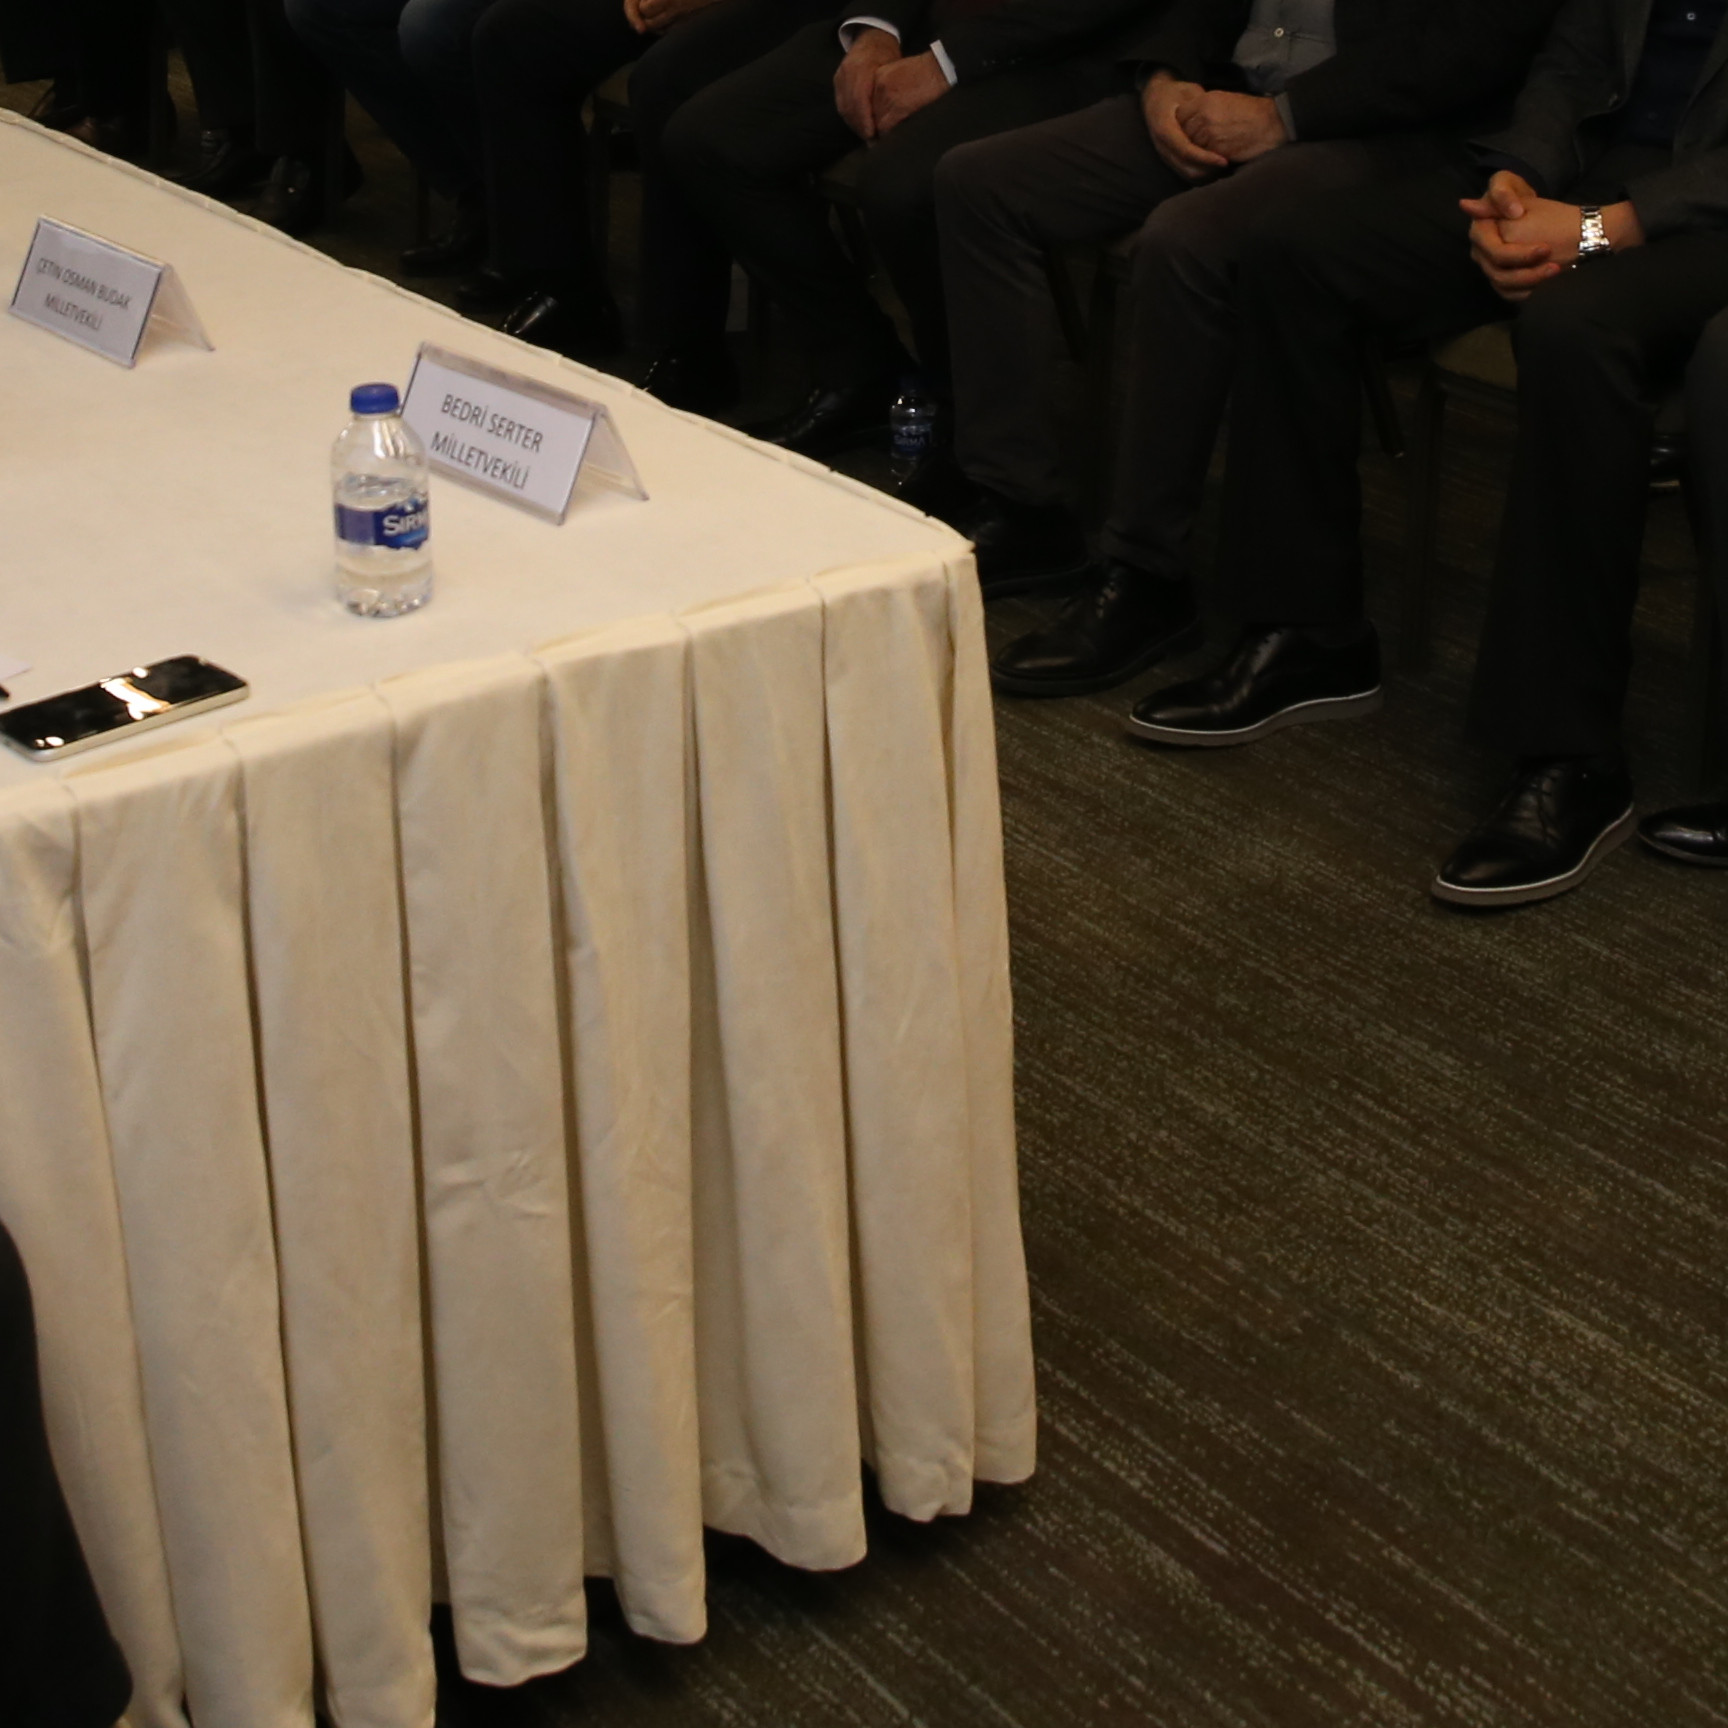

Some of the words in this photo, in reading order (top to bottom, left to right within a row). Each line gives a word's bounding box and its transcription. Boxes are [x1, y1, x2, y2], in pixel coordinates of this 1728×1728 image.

[441, 393, 489, 429] BEDRİ
[487, 415, 544, 454] SERTER
[430, 430, 532, 490] MİLLETVEKİLİ
